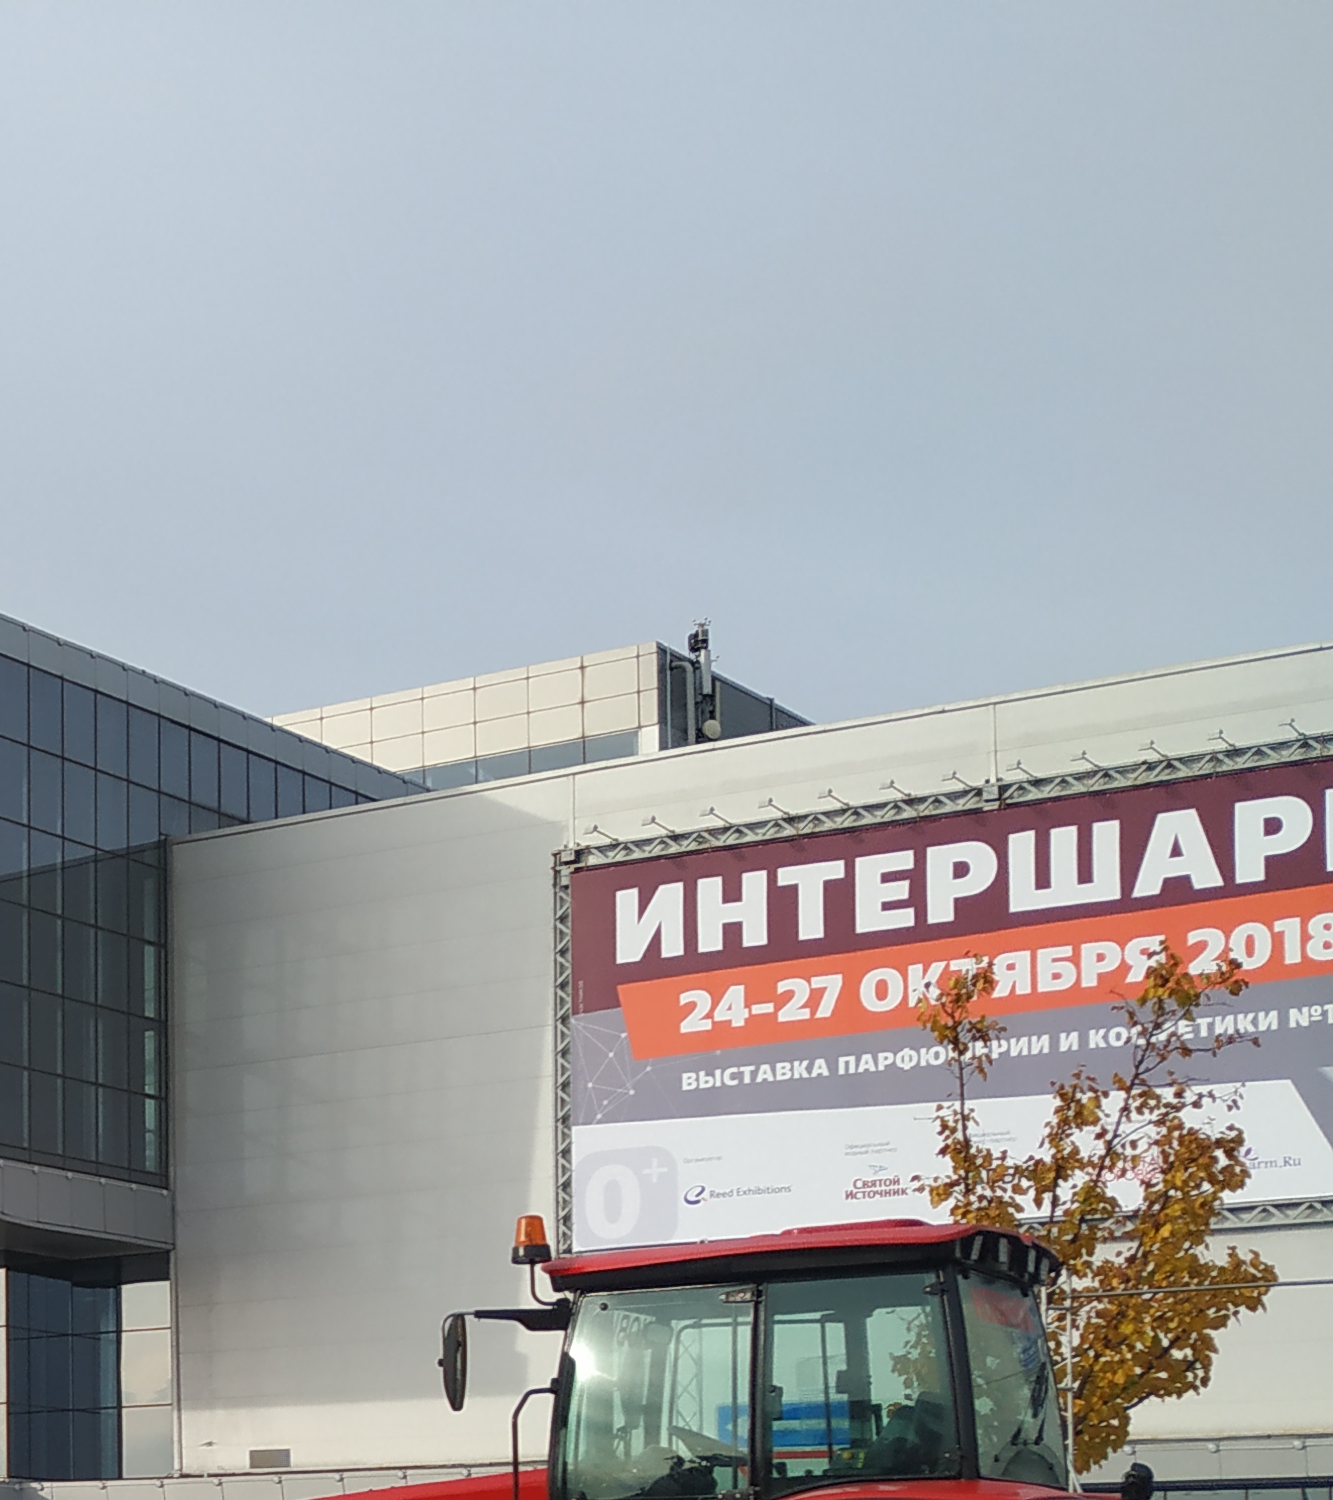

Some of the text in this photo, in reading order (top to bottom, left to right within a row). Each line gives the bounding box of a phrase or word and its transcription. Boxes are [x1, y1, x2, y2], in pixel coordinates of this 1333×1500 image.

[615, 788, 1333, 964] ИНТЕРШАР
[679, 974, 844, 1034] 24-27
[1186, 912, 1333, 976] 2018
[681, 1058, 830, 1091] ВЫСТАВКА
[1059, 1031, 1079, 1052] И
[1289, 1003, 1333, 1028] №1
[709, 1185, 792, 1200] Reed Exhibitions
